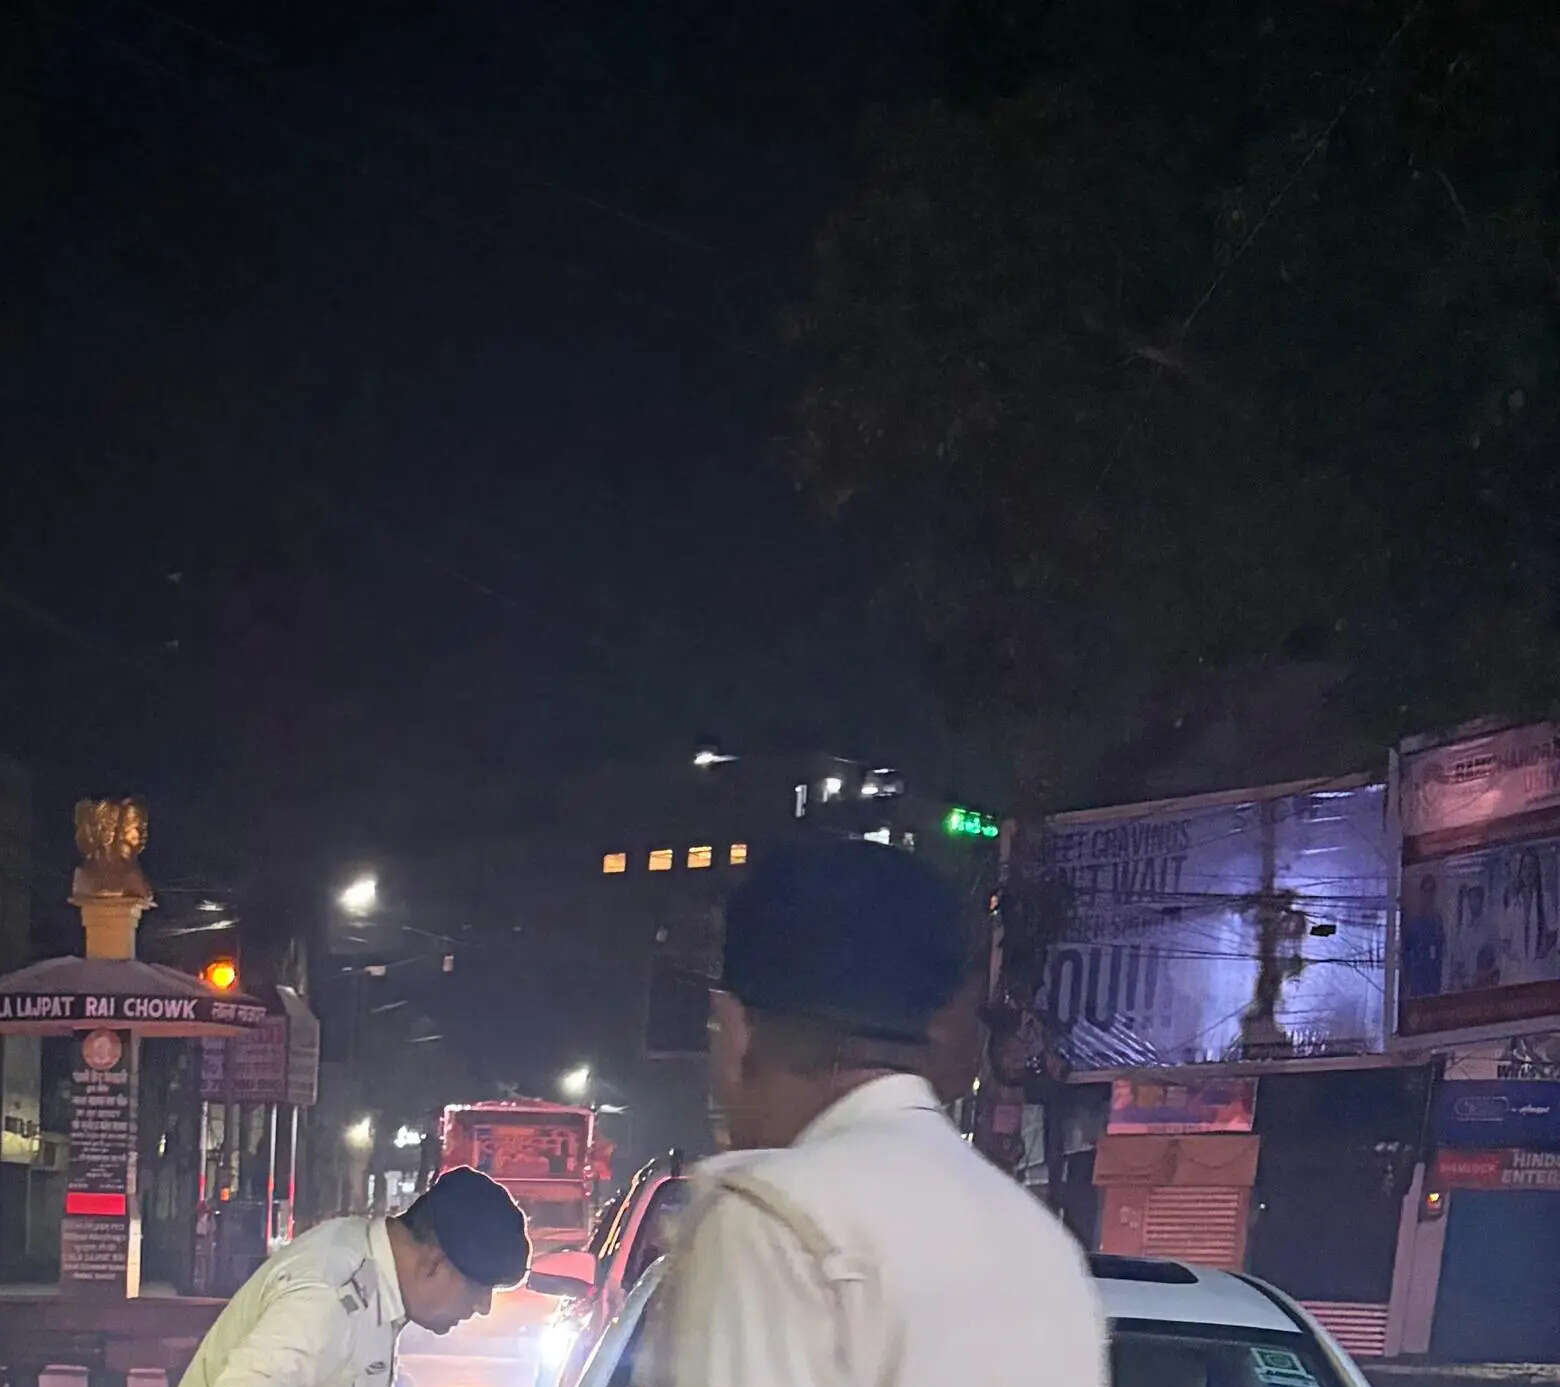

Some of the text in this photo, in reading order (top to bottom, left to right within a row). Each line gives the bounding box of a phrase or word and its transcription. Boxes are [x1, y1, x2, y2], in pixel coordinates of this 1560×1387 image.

[16, 996, 75, 1018] LAJPAT
[85, 996, 114, 1017] RAI
[123, 997, 199, 1019] CHOWK
